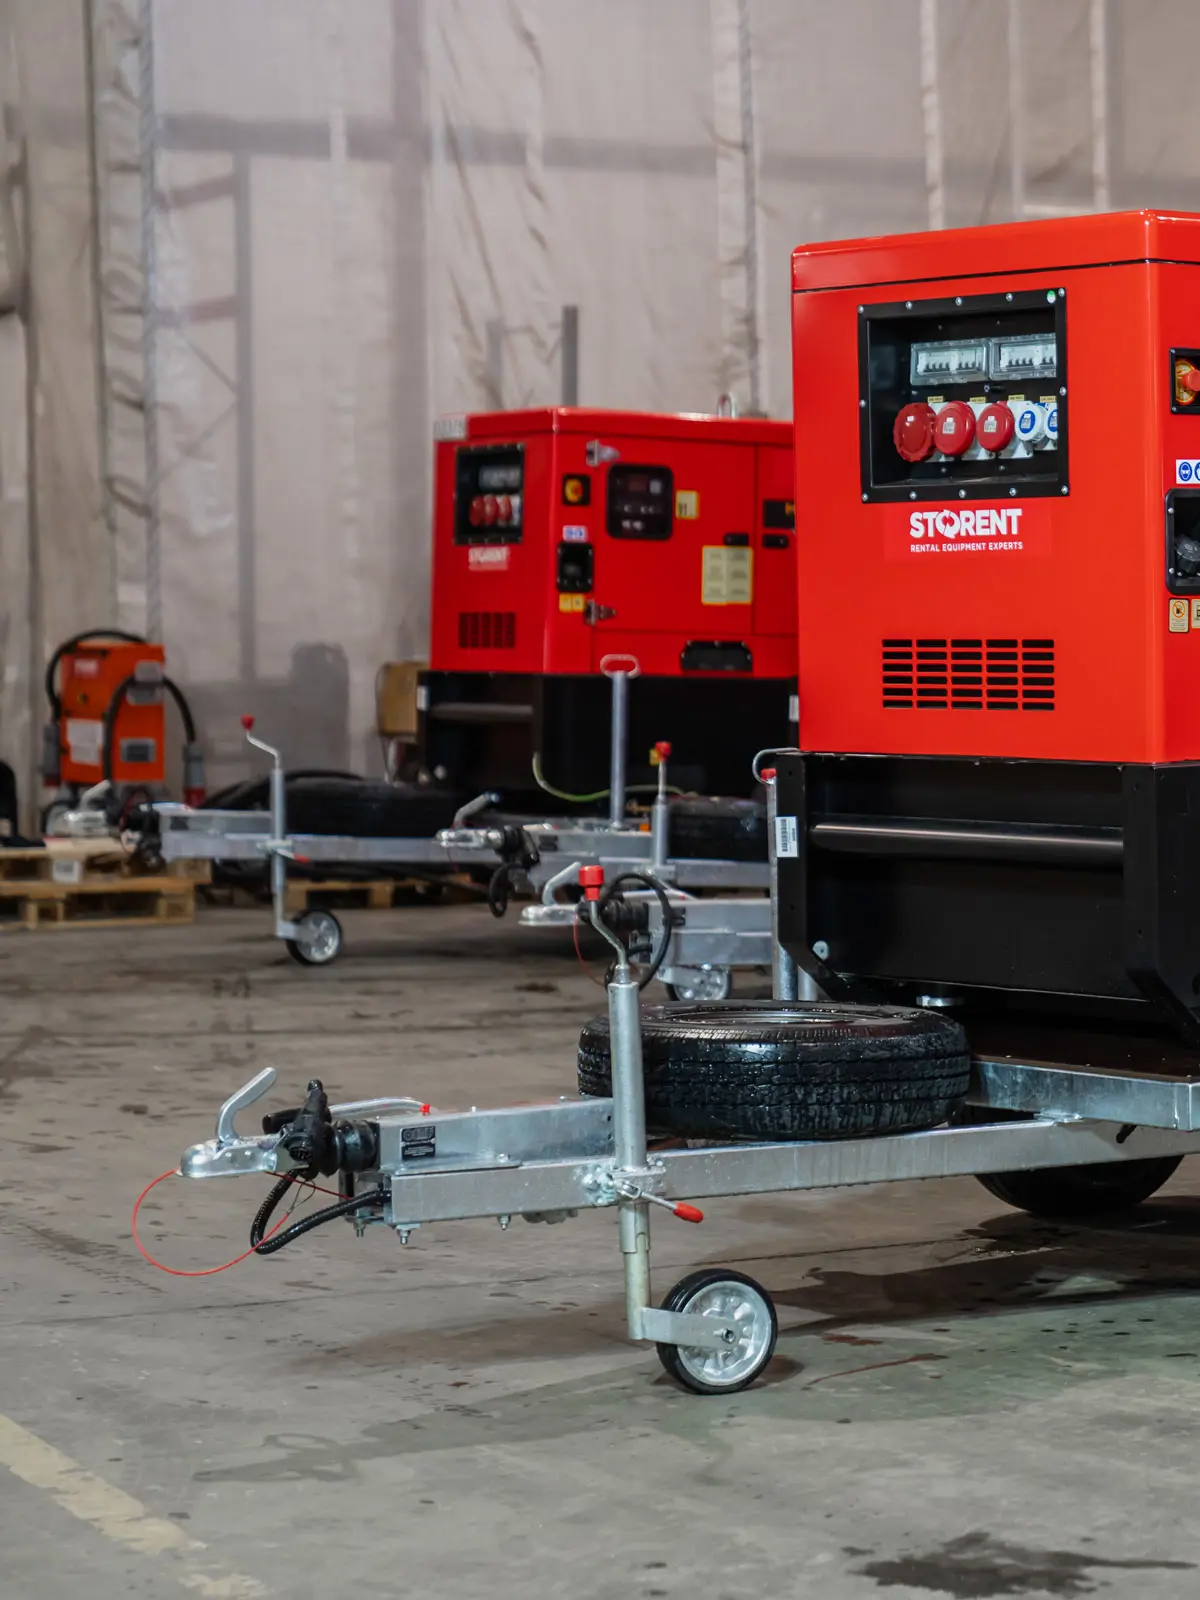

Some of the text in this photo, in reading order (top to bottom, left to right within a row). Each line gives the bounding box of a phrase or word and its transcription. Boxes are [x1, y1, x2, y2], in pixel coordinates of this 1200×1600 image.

[909, 508, 1023, 539] STORENT
[910, 541, 1024, 553] RENTAL EQUIPMENT EXPERTS
